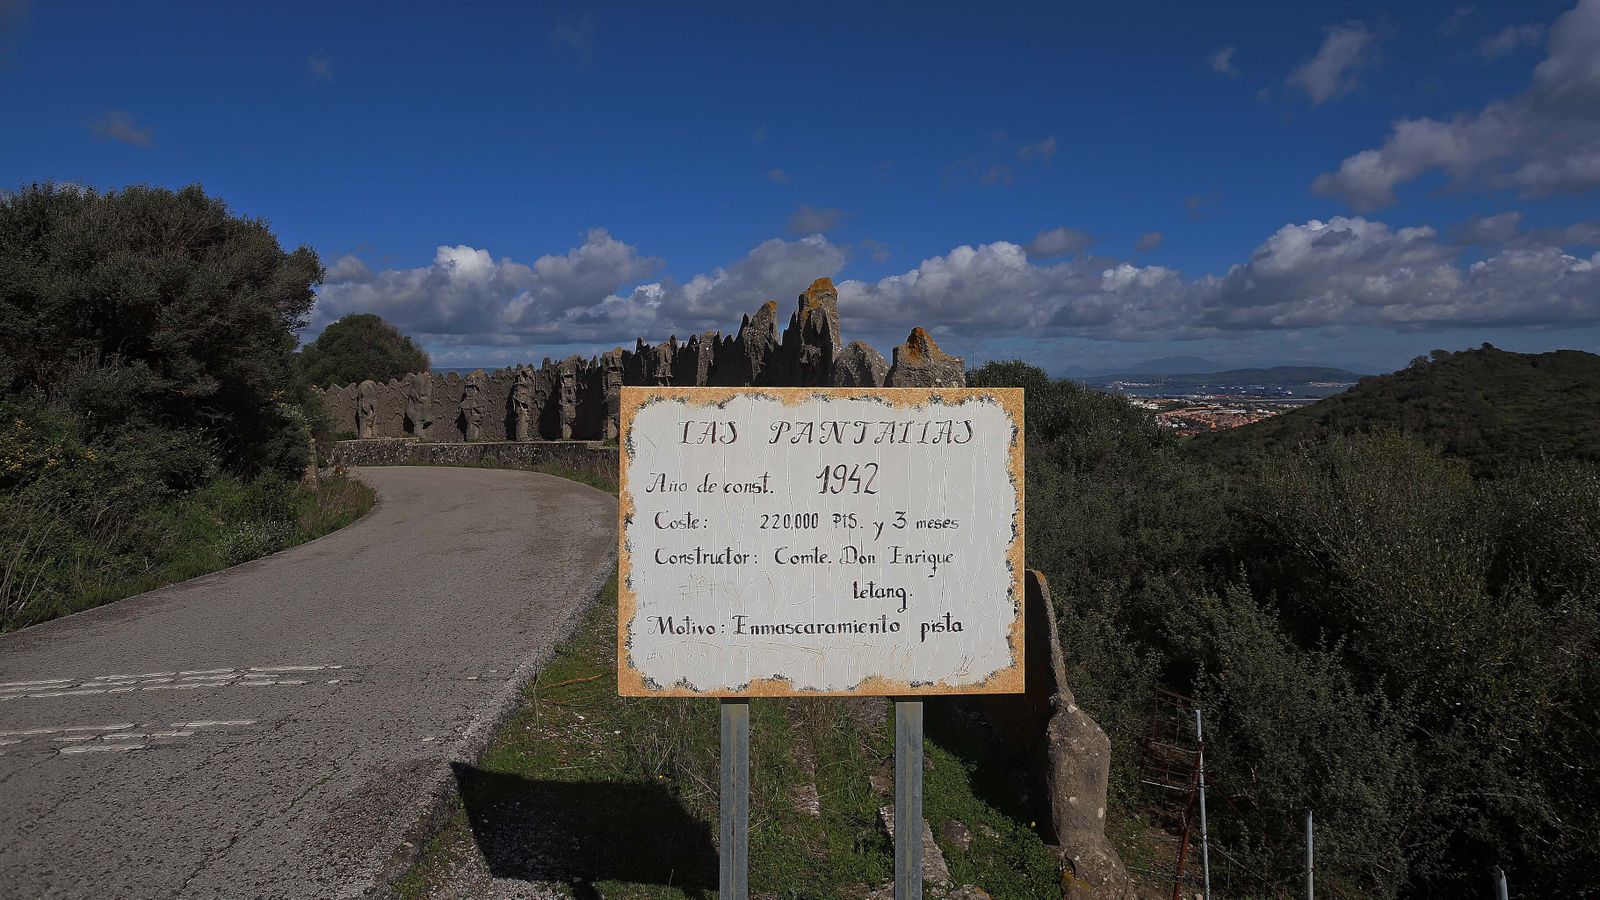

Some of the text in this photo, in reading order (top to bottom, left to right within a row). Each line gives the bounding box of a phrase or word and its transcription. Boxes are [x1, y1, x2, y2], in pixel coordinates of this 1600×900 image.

[646, 462, 879, 495] Año de const. 1942
[654, 510, 708, 530] Coste:
[872, 520, 884, 541] y
[892, 510, 907, 530] 3
[915, 517, 960, 530] meses
[654, 545, 954, 578] Constructor: Comte. Don Enrique
[646, 612, 964, 643] Motivo: Enmascaramiento pista
